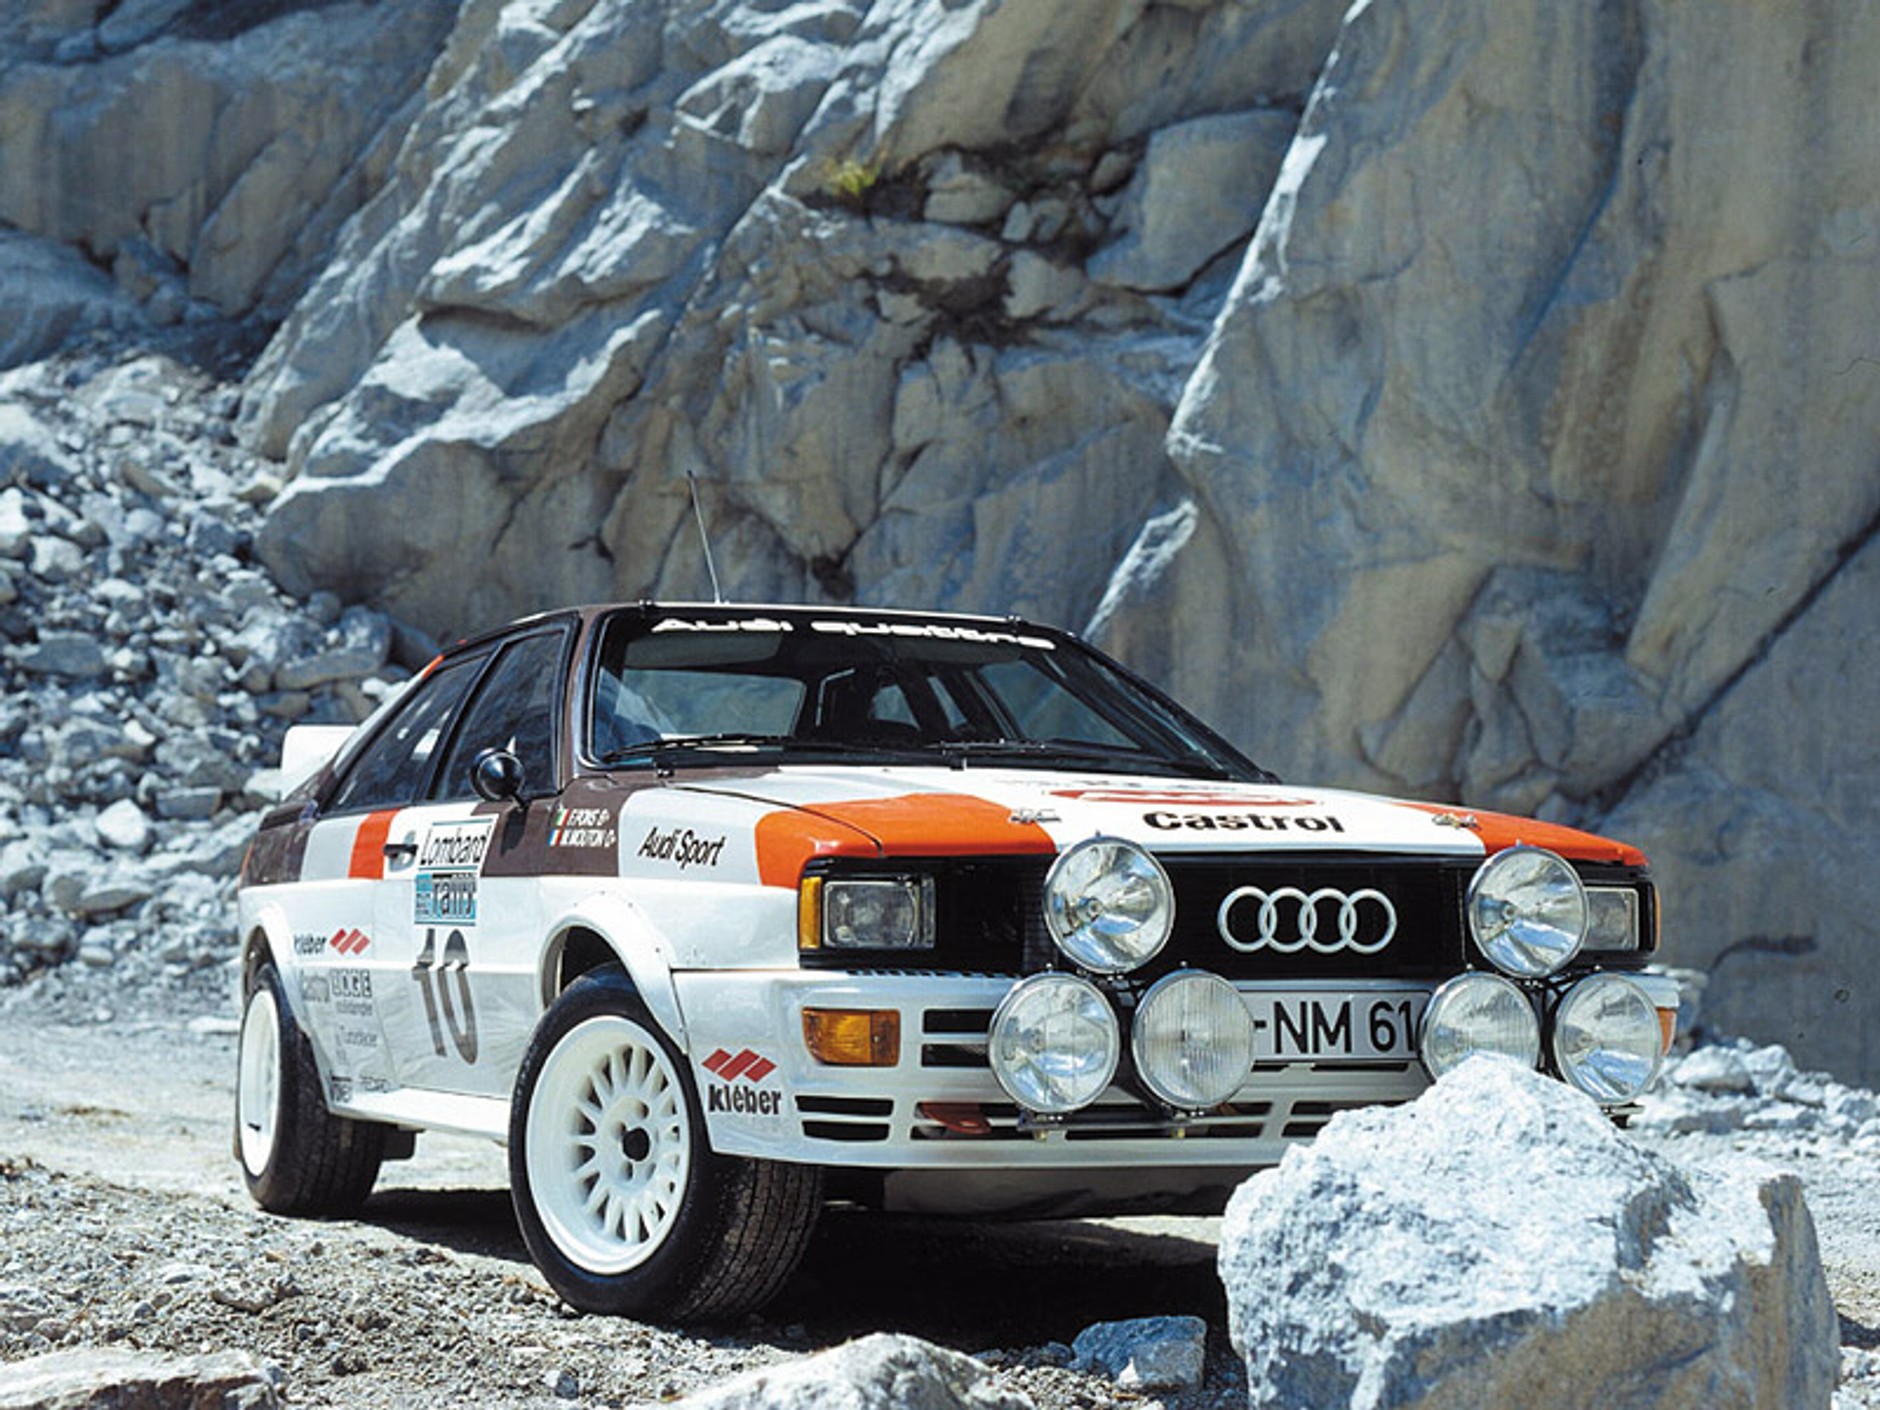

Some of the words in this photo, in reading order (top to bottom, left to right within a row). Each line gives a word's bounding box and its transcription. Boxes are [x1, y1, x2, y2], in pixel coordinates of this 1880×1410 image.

[1143, 811, 1345, 833] Castrol
[637, 826, 680, 861] Audi
[674, 829, 726, 870] Sport
[411, 927, 478, 1066] 10
[1369, 1000, 1415, 1053] 61
